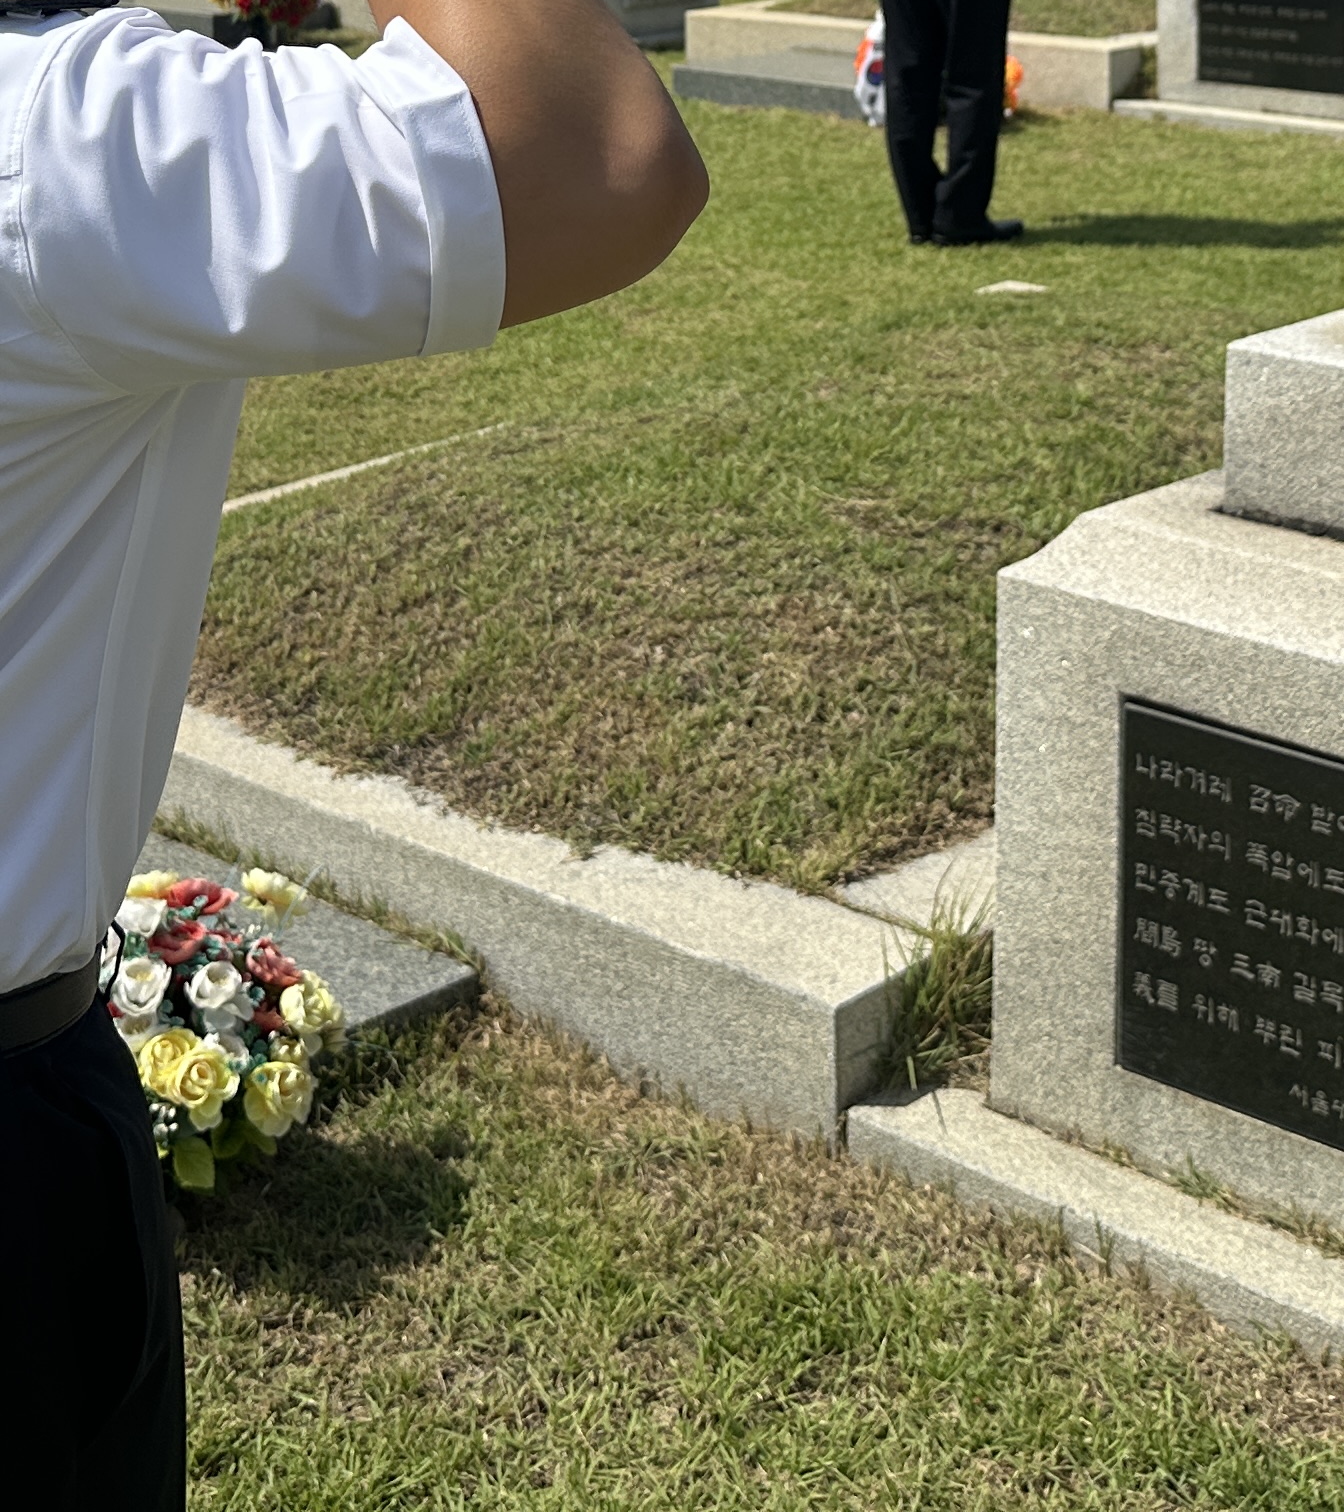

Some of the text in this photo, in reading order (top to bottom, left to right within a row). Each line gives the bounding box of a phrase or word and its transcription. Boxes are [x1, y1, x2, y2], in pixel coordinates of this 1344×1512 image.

[1135, 753, 1231, 802] 나라겨레
[1135, 808, 1230, 860] 침략자의
[1244, 899, 1344, 954] 근대화에
[1193, 937, 1217, 966] 땅
[1230, 952, 1281, 987] 三南
[1293, 971, 1343, 1012] 길목
[1192, 993, 1238, 1031] 위해
[1253, 1015, 1302, 1057] 뿌린
